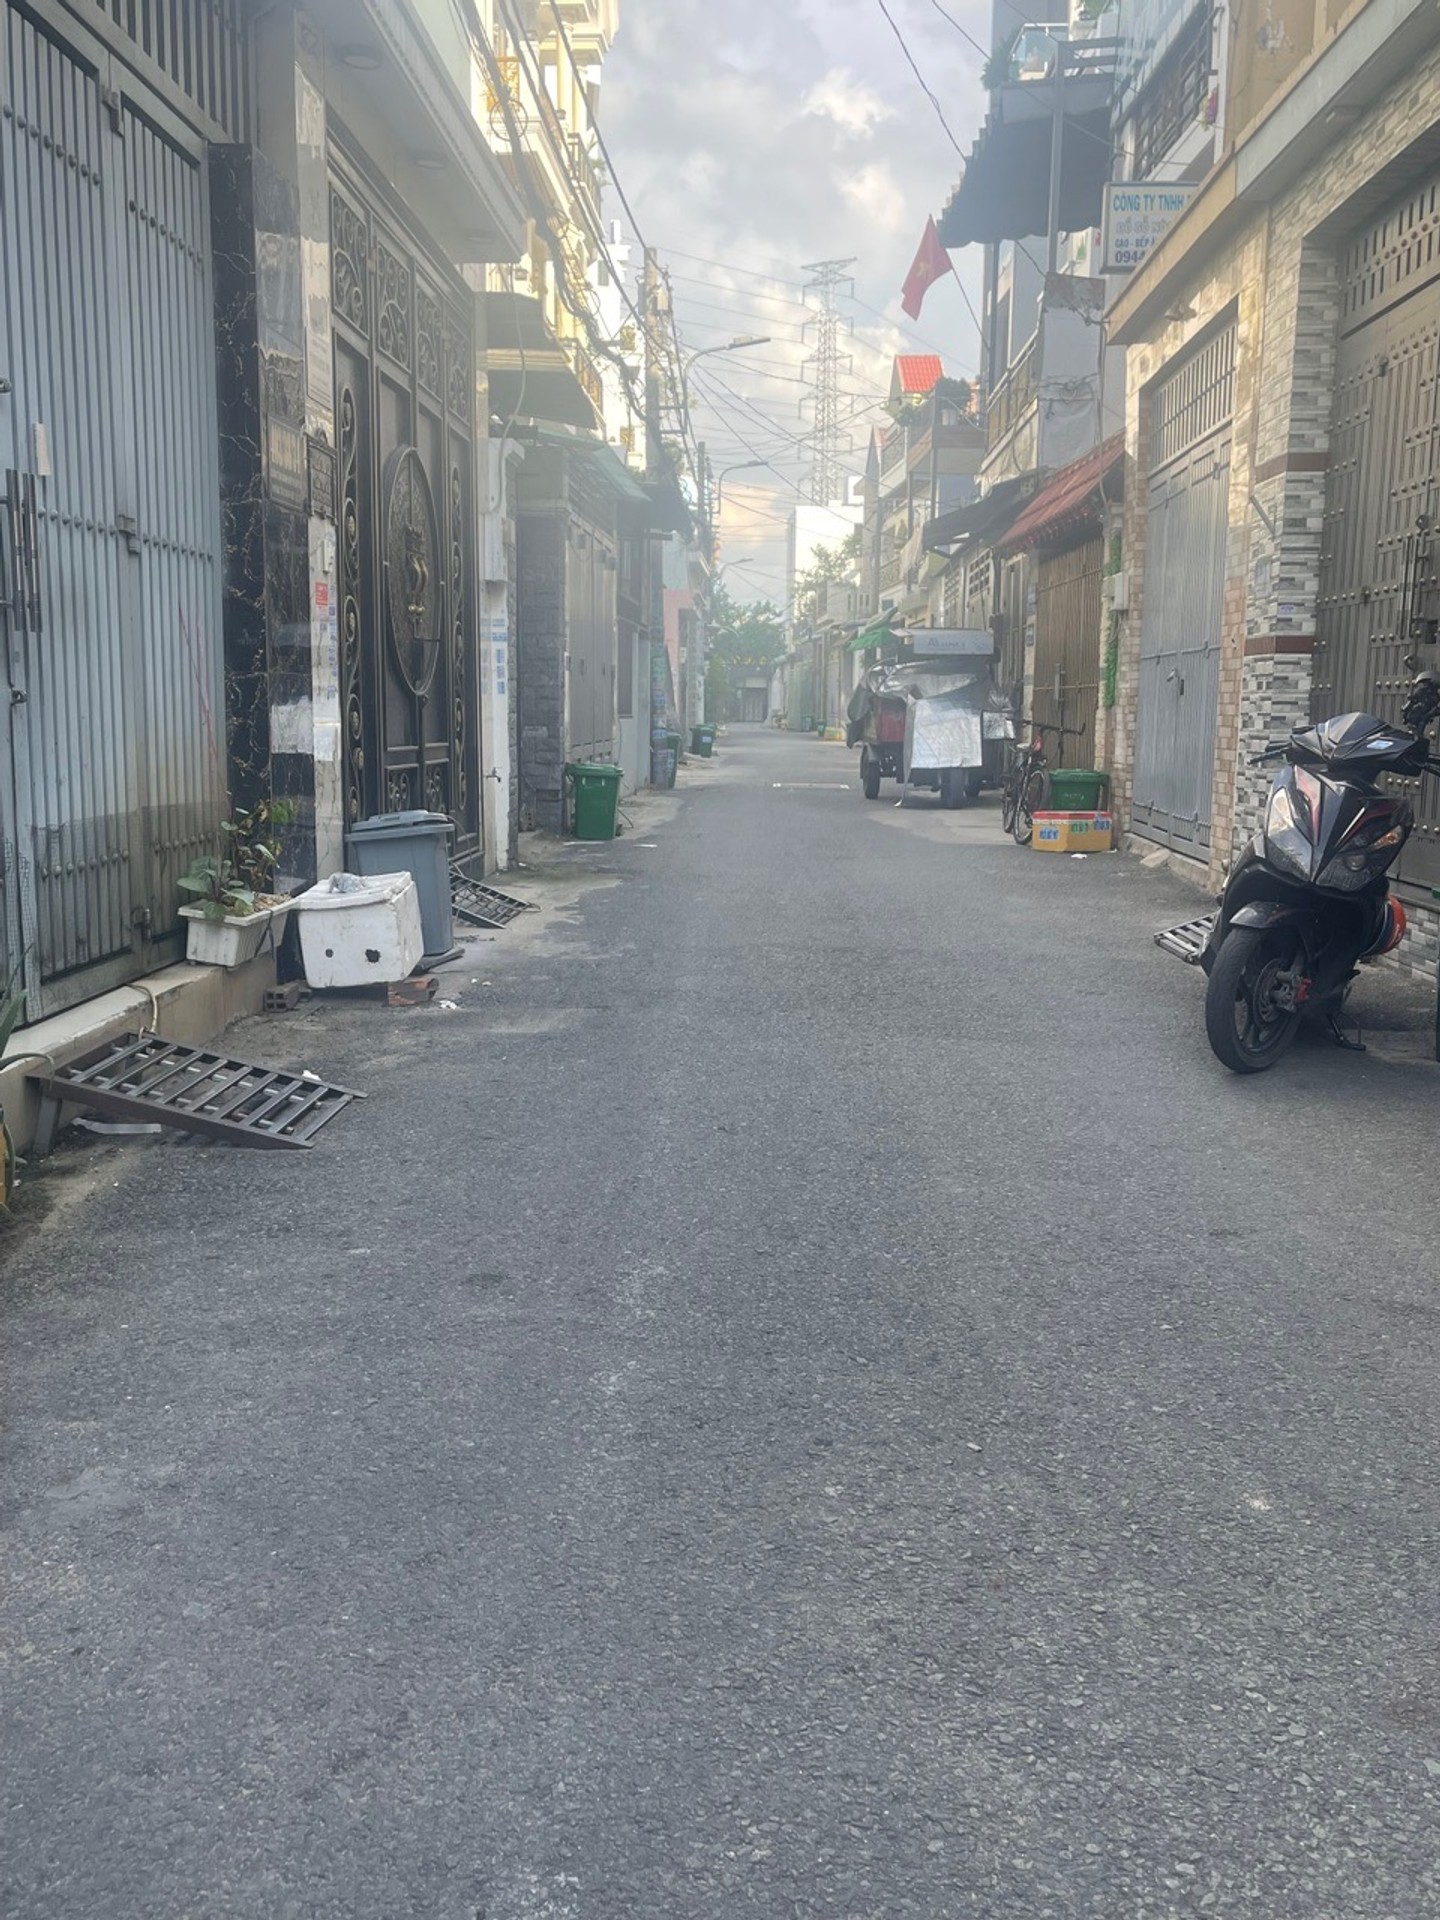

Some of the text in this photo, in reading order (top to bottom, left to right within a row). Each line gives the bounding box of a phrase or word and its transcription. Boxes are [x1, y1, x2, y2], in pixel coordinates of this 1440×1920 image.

[1113, 191, 1140, 212] CÔNG
[1143, 194, 1156, 211] TY
[1158, 194, 1184, 211] TNHH
